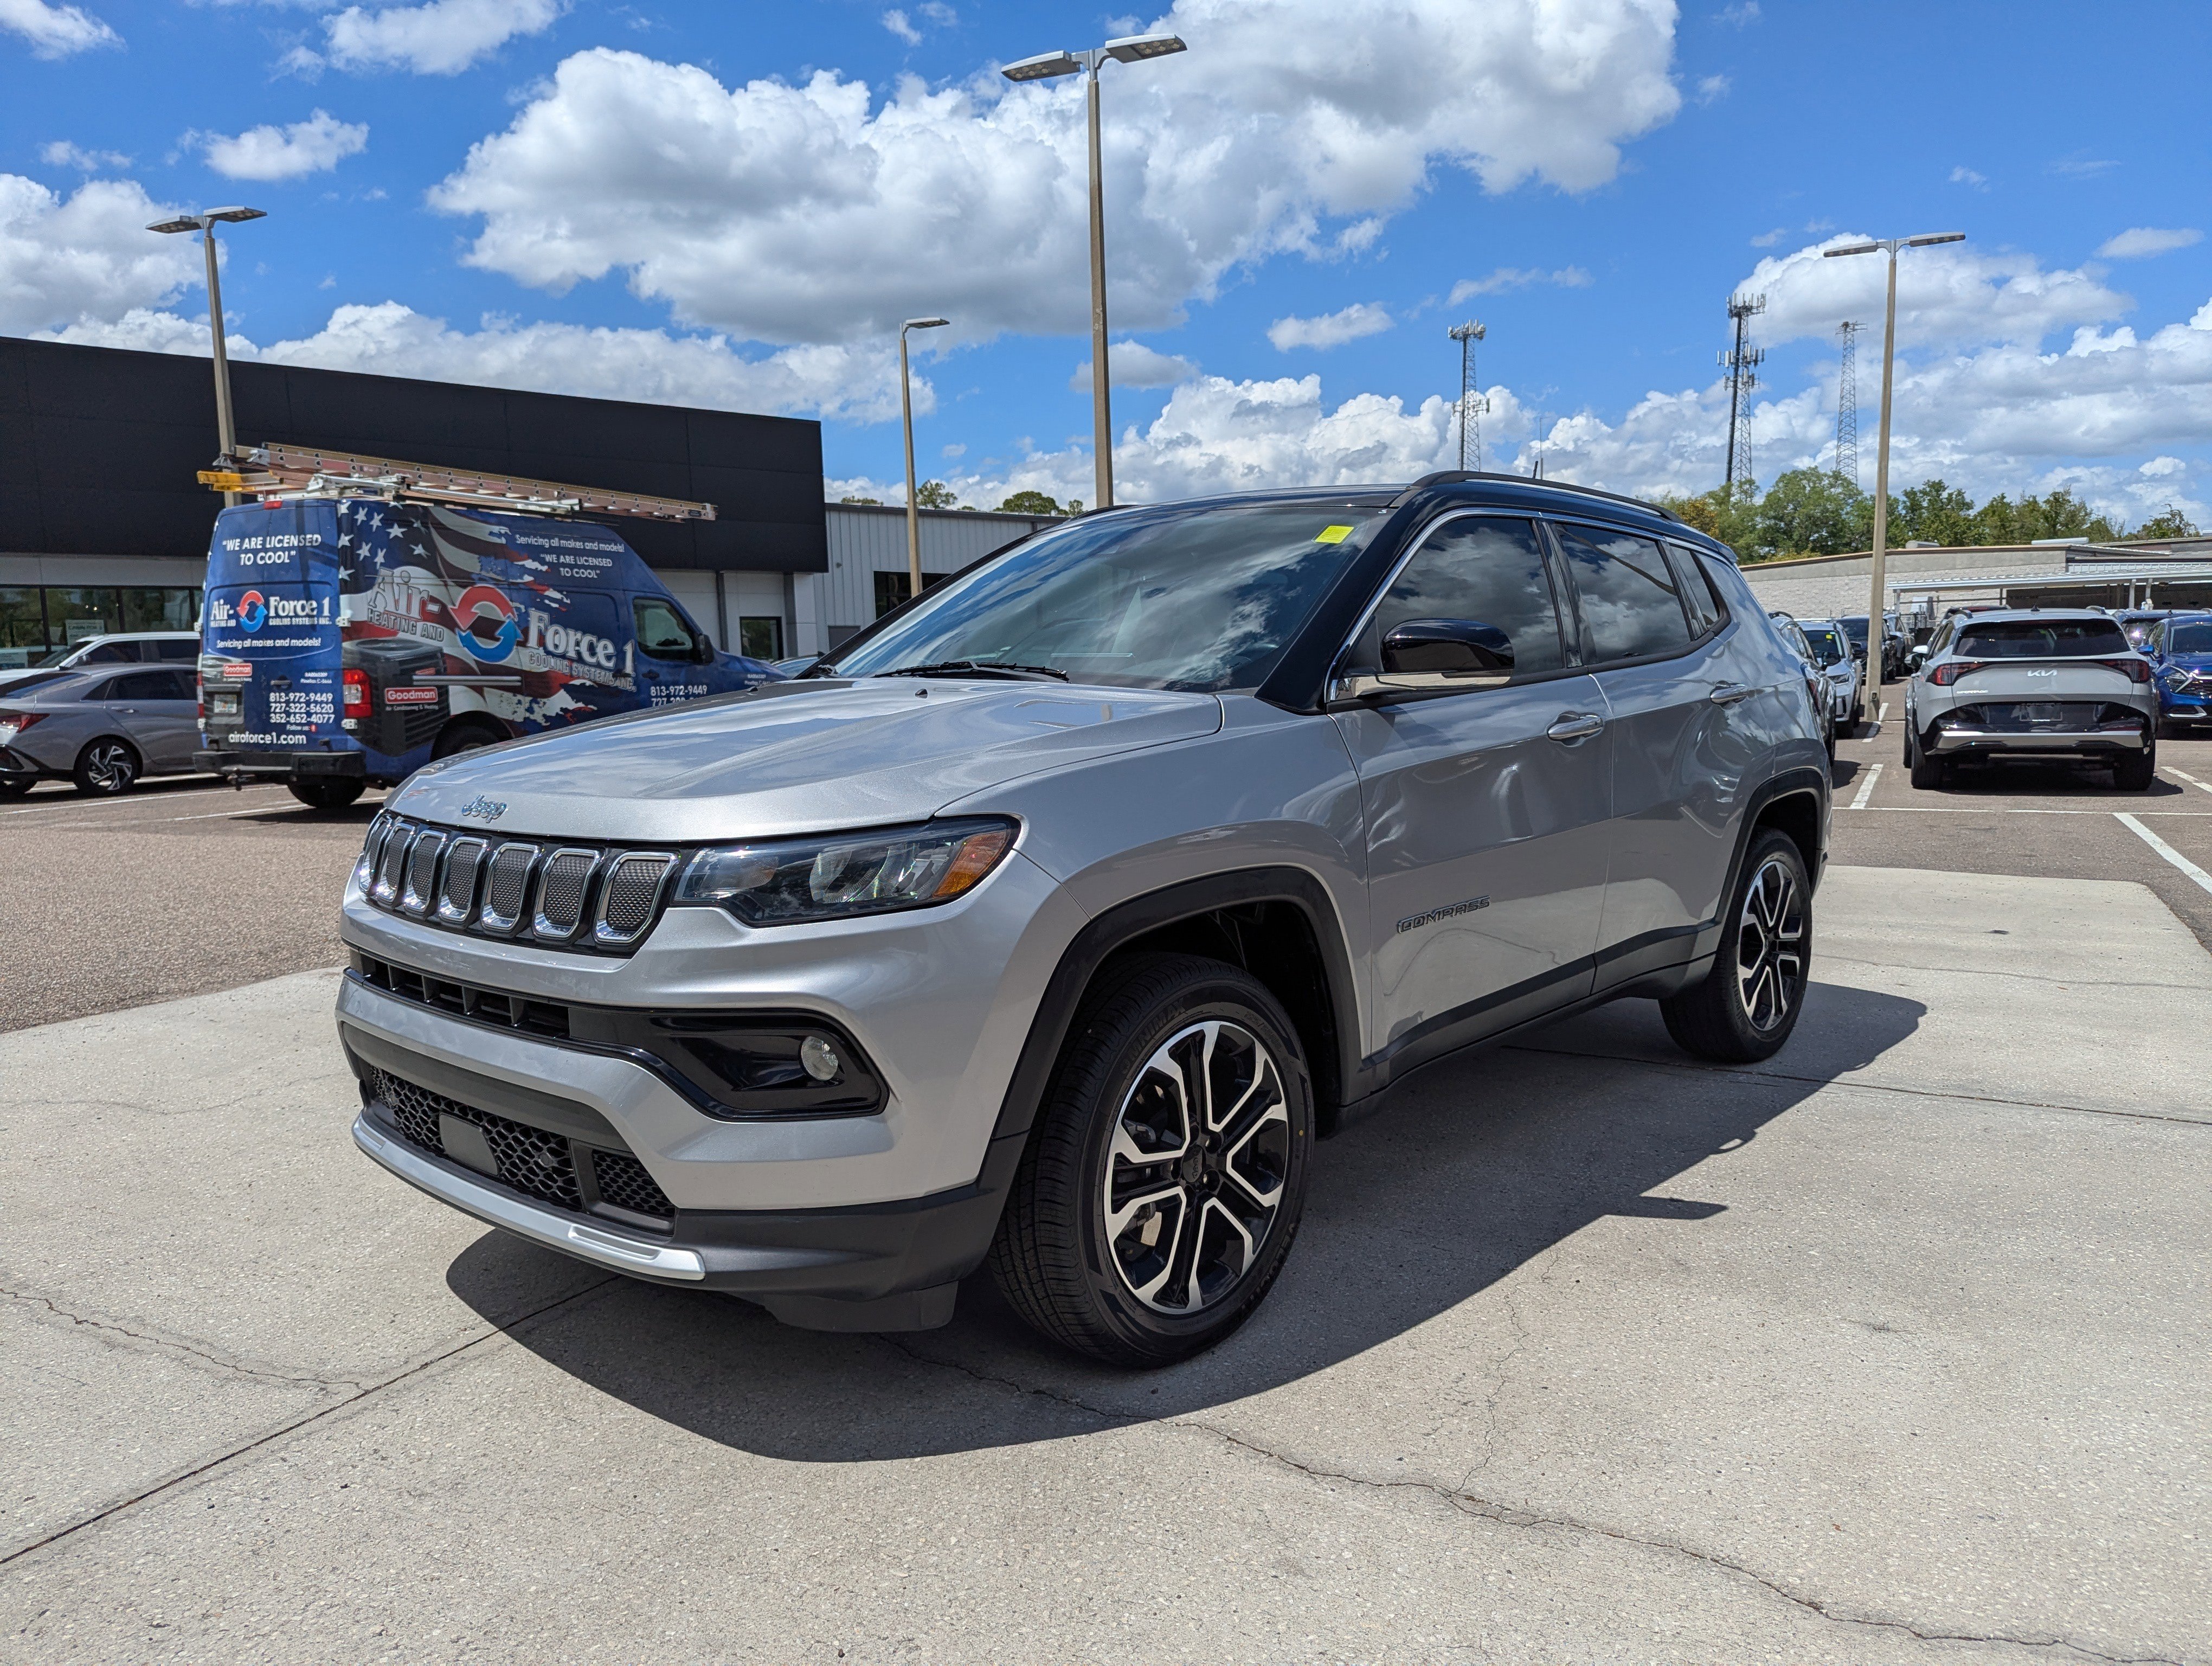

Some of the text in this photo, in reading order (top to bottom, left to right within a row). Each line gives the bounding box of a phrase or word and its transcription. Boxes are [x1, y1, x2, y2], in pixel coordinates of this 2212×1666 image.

[242, 537, 263, 550] ARE
[266, 534, 321, 548] LICENSED
[516, 534, 549, 548] Servicing
[551, 537, 559, 547] all
[560, 540, 583, 549] makes
[584, 541, 598, 550] and
[239, 553, 254, 566] TO
[560, 555, 575, 564] ARE
[576, 556, 613, 567] LICENSED
[559, 568, 571, 576] TO
[269, 597, 317, 616] Force
[322, 597, 331, 616] 1
[217, 637, 321, 649] Servicing all makes and models!
[368, 607, 417, 635] HEATING
[420, 623, 445, 642] AND
[528, 651, 570, 675] COOLING
[572, 663, 615, 687] SYSTEMS
[526, 608, 617, 670] Force
[623, 639, 636, 677] 1
[269, 692, 333, 702] 813-972-9449
[388, 690, 436, 700] Goodman
[650, 685, 708, 696] 813-972-9449
[269, 703, 334, 713] 727-322-5620
[269, 714, 335, 723] 352-652-4077
[228, 731, 307, 744] airoforce1.com
[461, 794, 507, 824] Jeep
[1396, 895, 1491, 934] COMPASS
